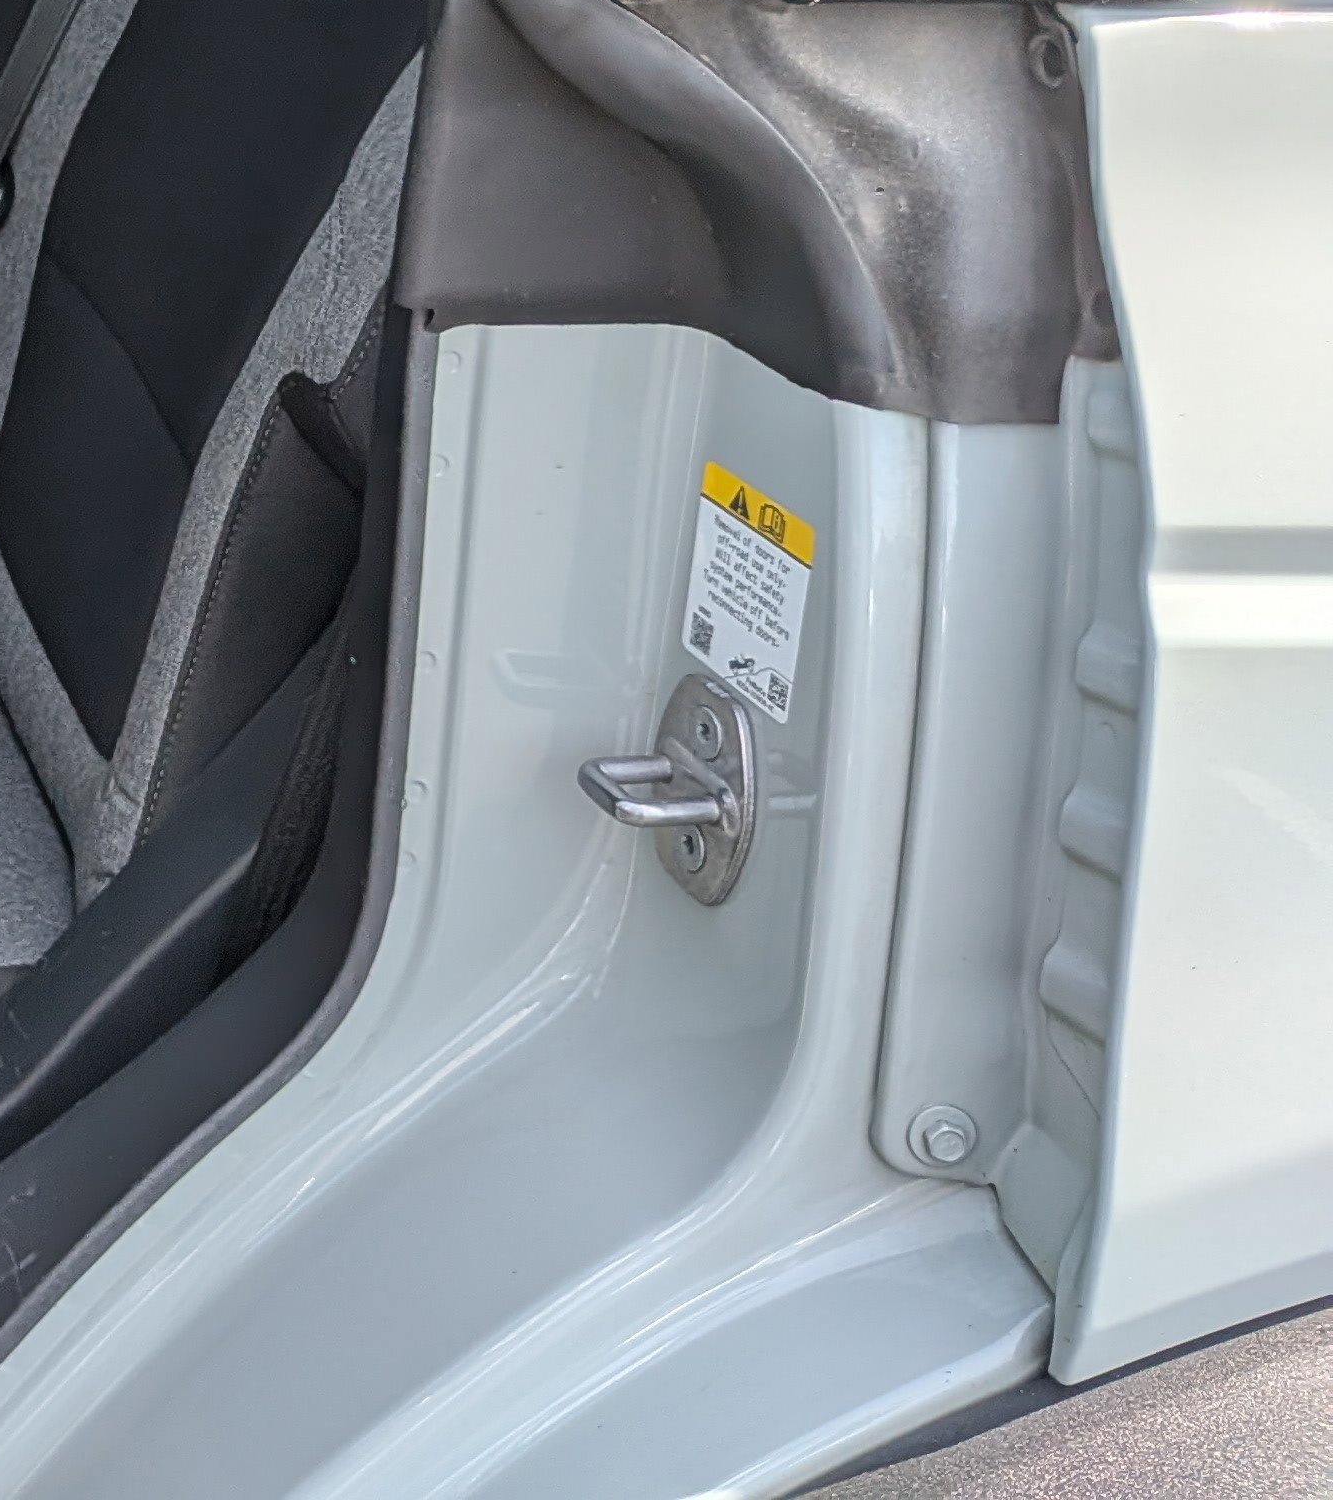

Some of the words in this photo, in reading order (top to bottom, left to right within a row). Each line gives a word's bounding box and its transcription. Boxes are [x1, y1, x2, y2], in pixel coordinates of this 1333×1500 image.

[714, 513, 741, 542] Removal
[742, 537, 752, 548] of
[755, 545, 775, 565] doors
[777, 559, 790, 574] for
[734, 563, 758, 586] affect
[760, 581, 784, 605] safety
[750, 605, 763, 620] off
